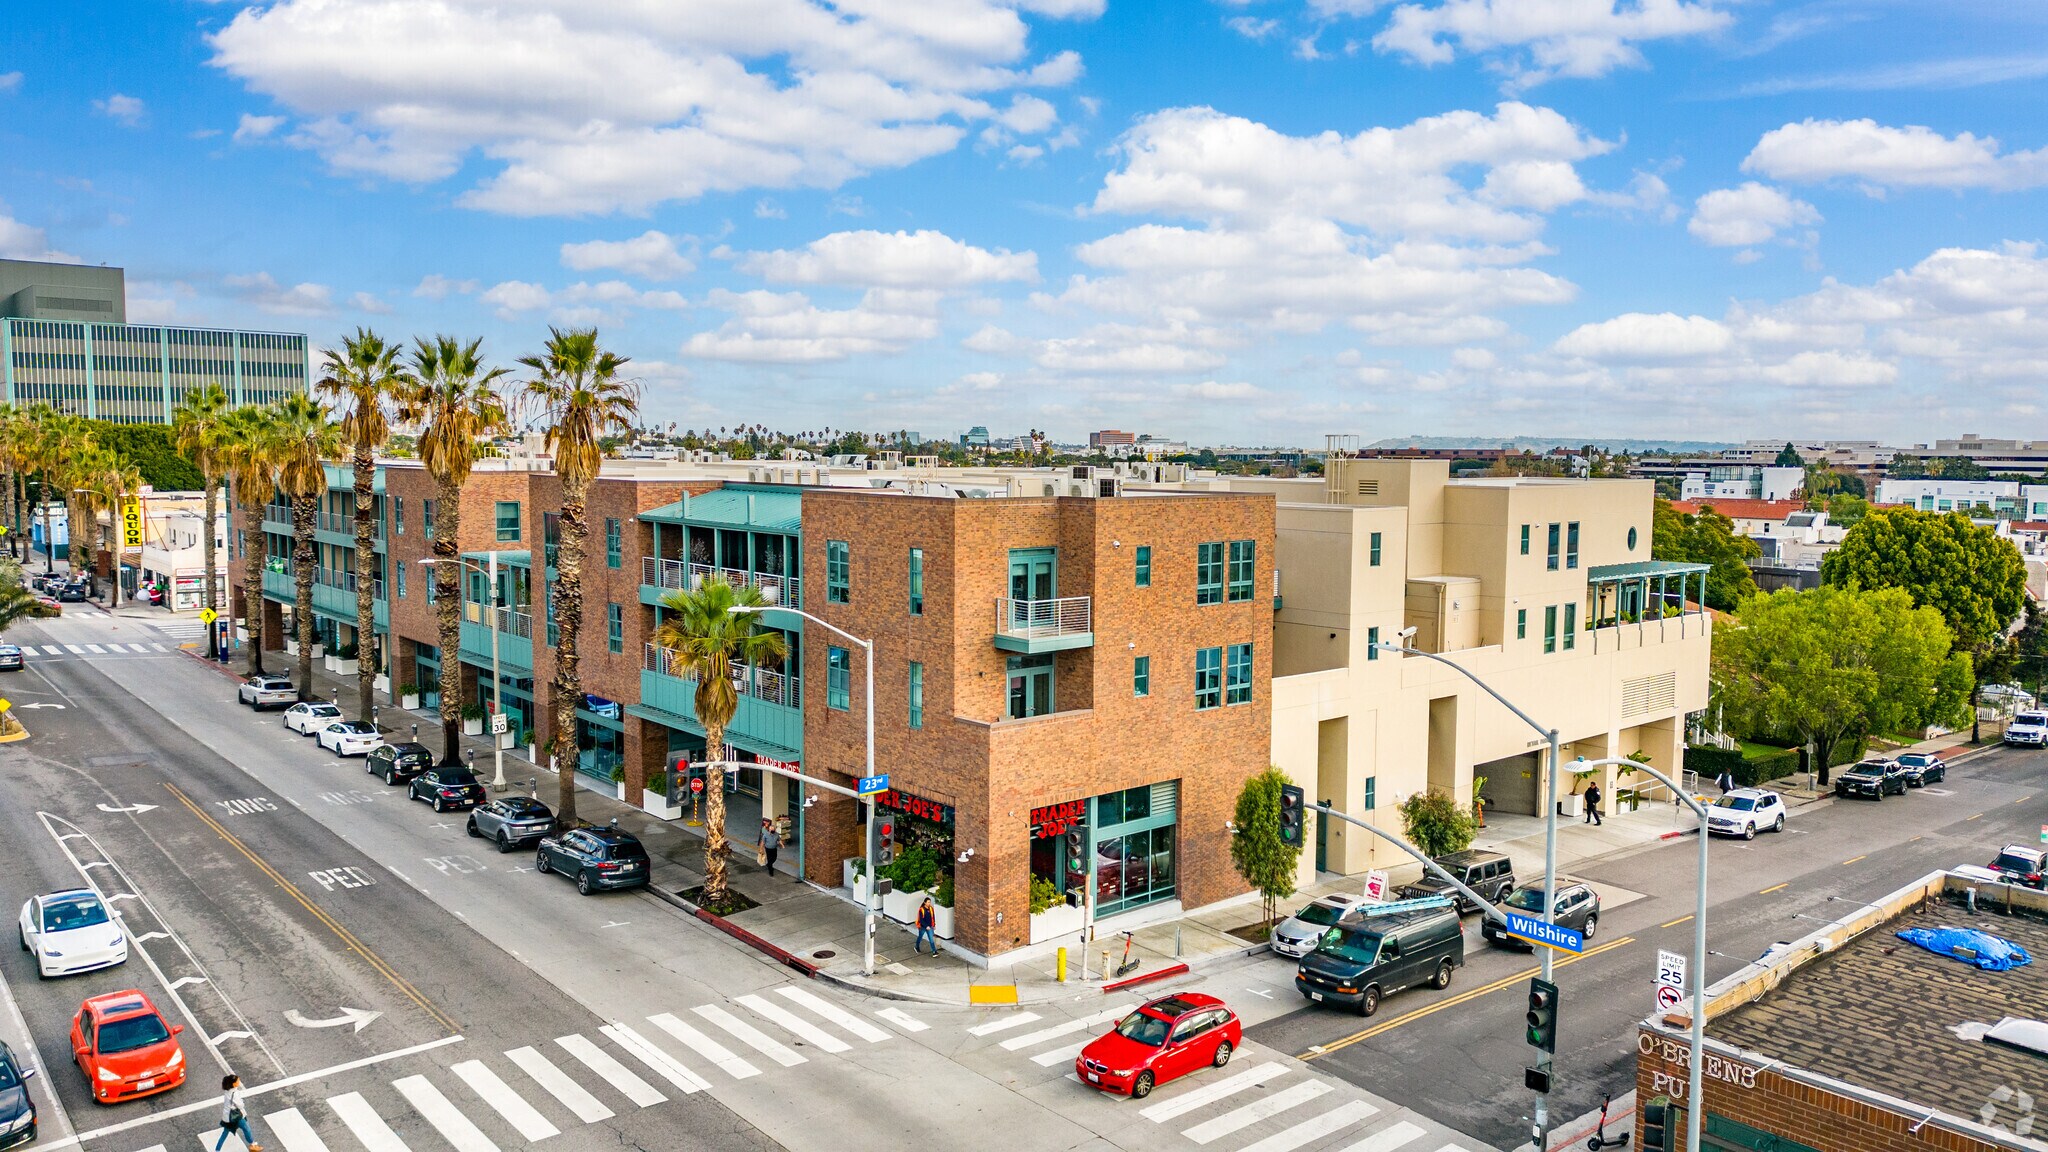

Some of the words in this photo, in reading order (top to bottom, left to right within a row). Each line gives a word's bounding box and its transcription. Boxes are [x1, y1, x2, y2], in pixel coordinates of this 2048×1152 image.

[494, 723, 506, 732] 30
[864, 777, 884, 790] 23rd
[215, 796, 279, 816] XING
[903, 796, 942, 822] JOE'S
[1031, 799, 1086, 825] TRADER
[423, 854, 487, 876] PED
[307, 866, 377, 892] PED
[1511, 916, 1578, 947] Wilshire
[1660, 953, 1684, 966] SPEED
[1662, 961, 1681, 971] LIMIT
[1660, 968, 1682, 985] 25
[1638, 1033, 1756, 1089] O'BRENS
